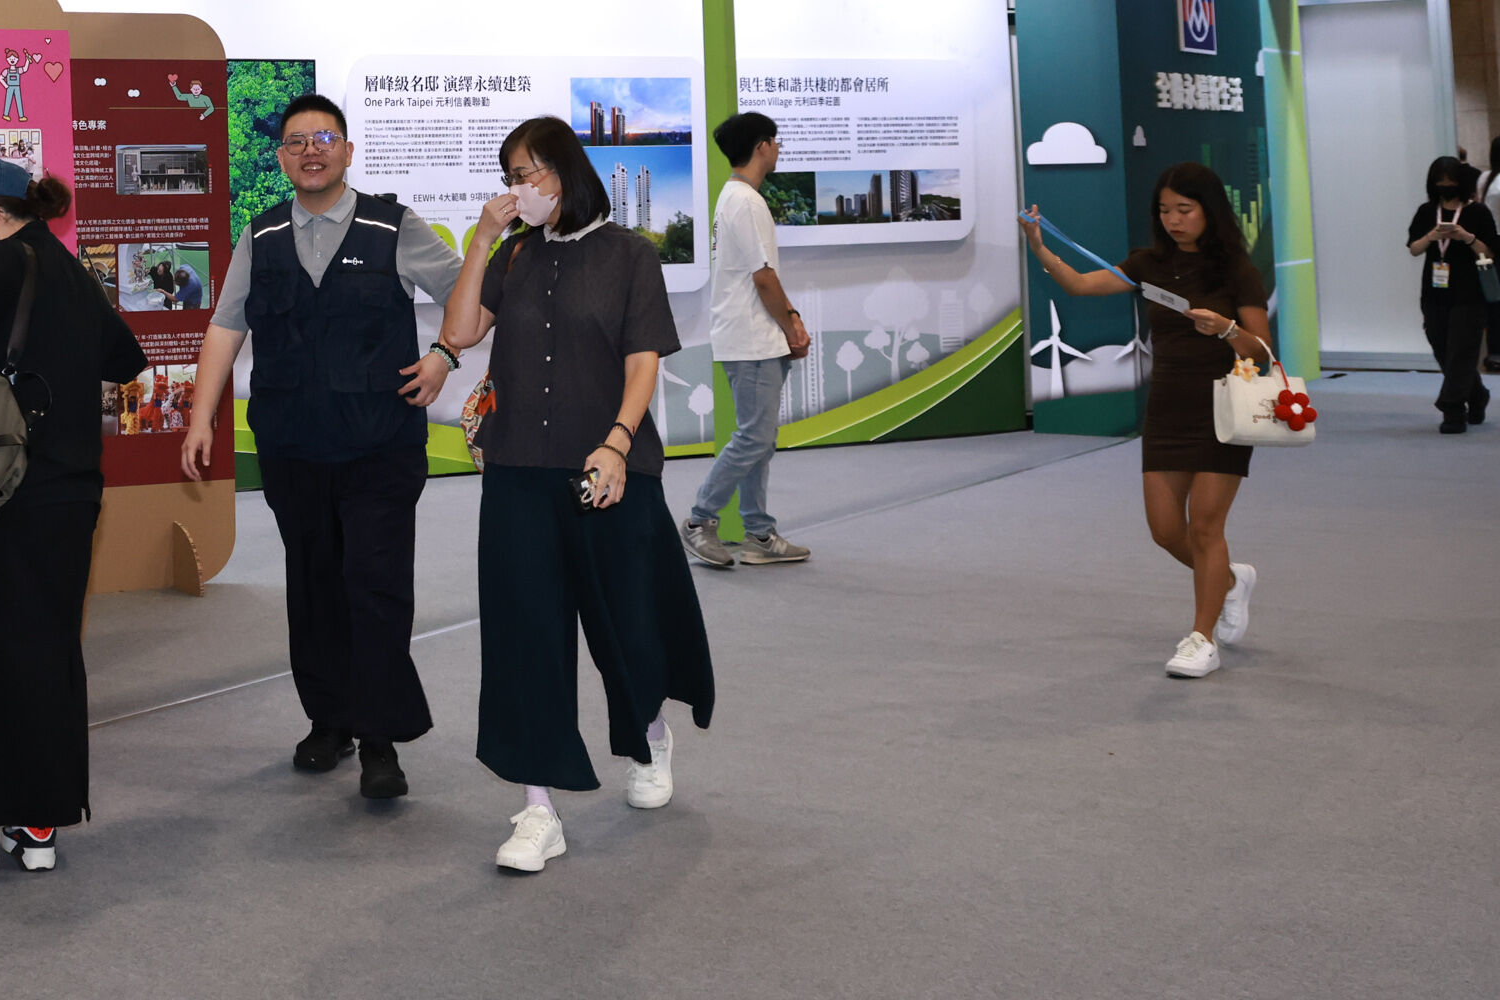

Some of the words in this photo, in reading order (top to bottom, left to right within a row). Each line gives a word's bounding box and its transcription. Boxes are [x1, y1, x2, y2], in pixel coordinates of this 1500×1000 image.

[365, 75, 439, 93] 層峰級名邸
[443, 75, 532, 93] 演繹永續建築
[739, 77, 889, 93] 與生態和諧共棲的都會居所
[365, 97, 383, 107] One
[385, 97, 405, 107] Park
[407, 97, 434, 109] Taipei
[435, 97, 490, 108] 元利信義聯勤
[739, 97, 766, 107] Season
[767, 97, 792, 109] Village
[413, 194, 436, 203] EEWH
